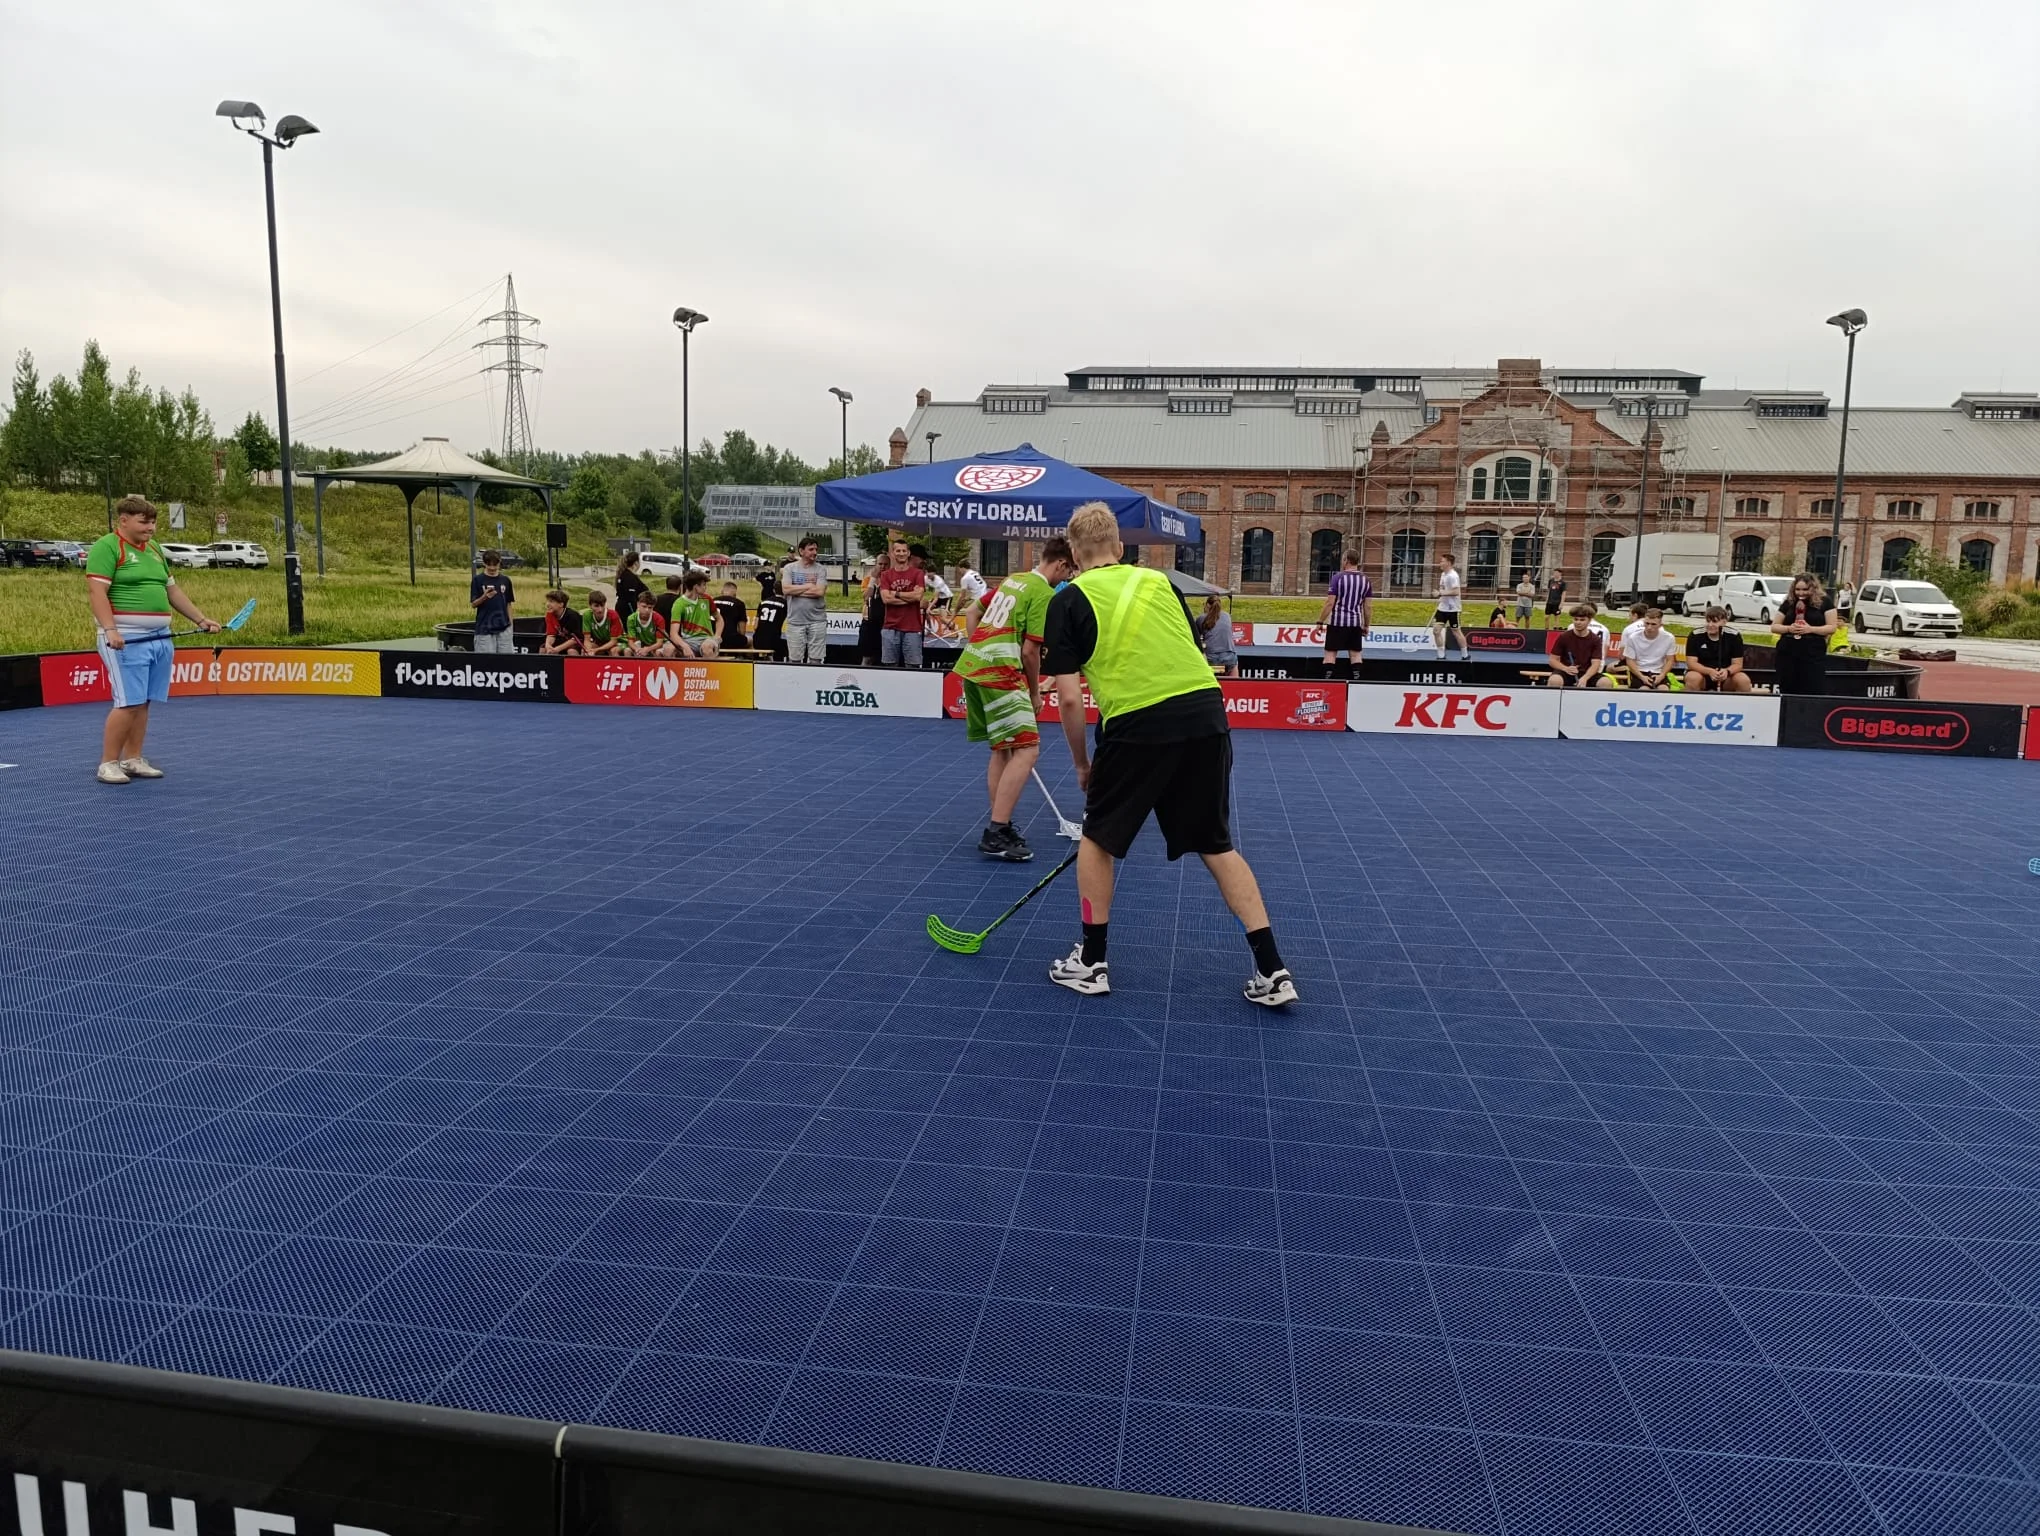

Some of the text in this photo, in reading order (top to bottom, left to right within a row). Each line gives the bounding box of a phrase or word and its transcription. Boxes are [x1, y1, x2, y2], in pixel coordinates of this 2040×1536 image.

[905, 496, 1048, 522] ČESKÝ FLORBAL
[760, 607, 777, 622] 31
[981, 591, 1016, 629] 88
[1471, 636, 1518, 646] BigBoard
[208, 662, 221, 682] &
[226, 662, 307, 682] OSTRAVA
[311, 663, 354, 683] 2025
[395, 662, 549, 693] florbalexpert
[684, 668, 708, 678] BRNO
[684, 679, 720, 690] OSTRAVA
[684, 691, 705, 701] 2025
[816, 690, 879, 708] HOLBA
[1395, 693, 1512, 730] KFC
[1595, 702, 1744, 731] deník.cz
[1841, 718, 1952, 738] BigBoard
